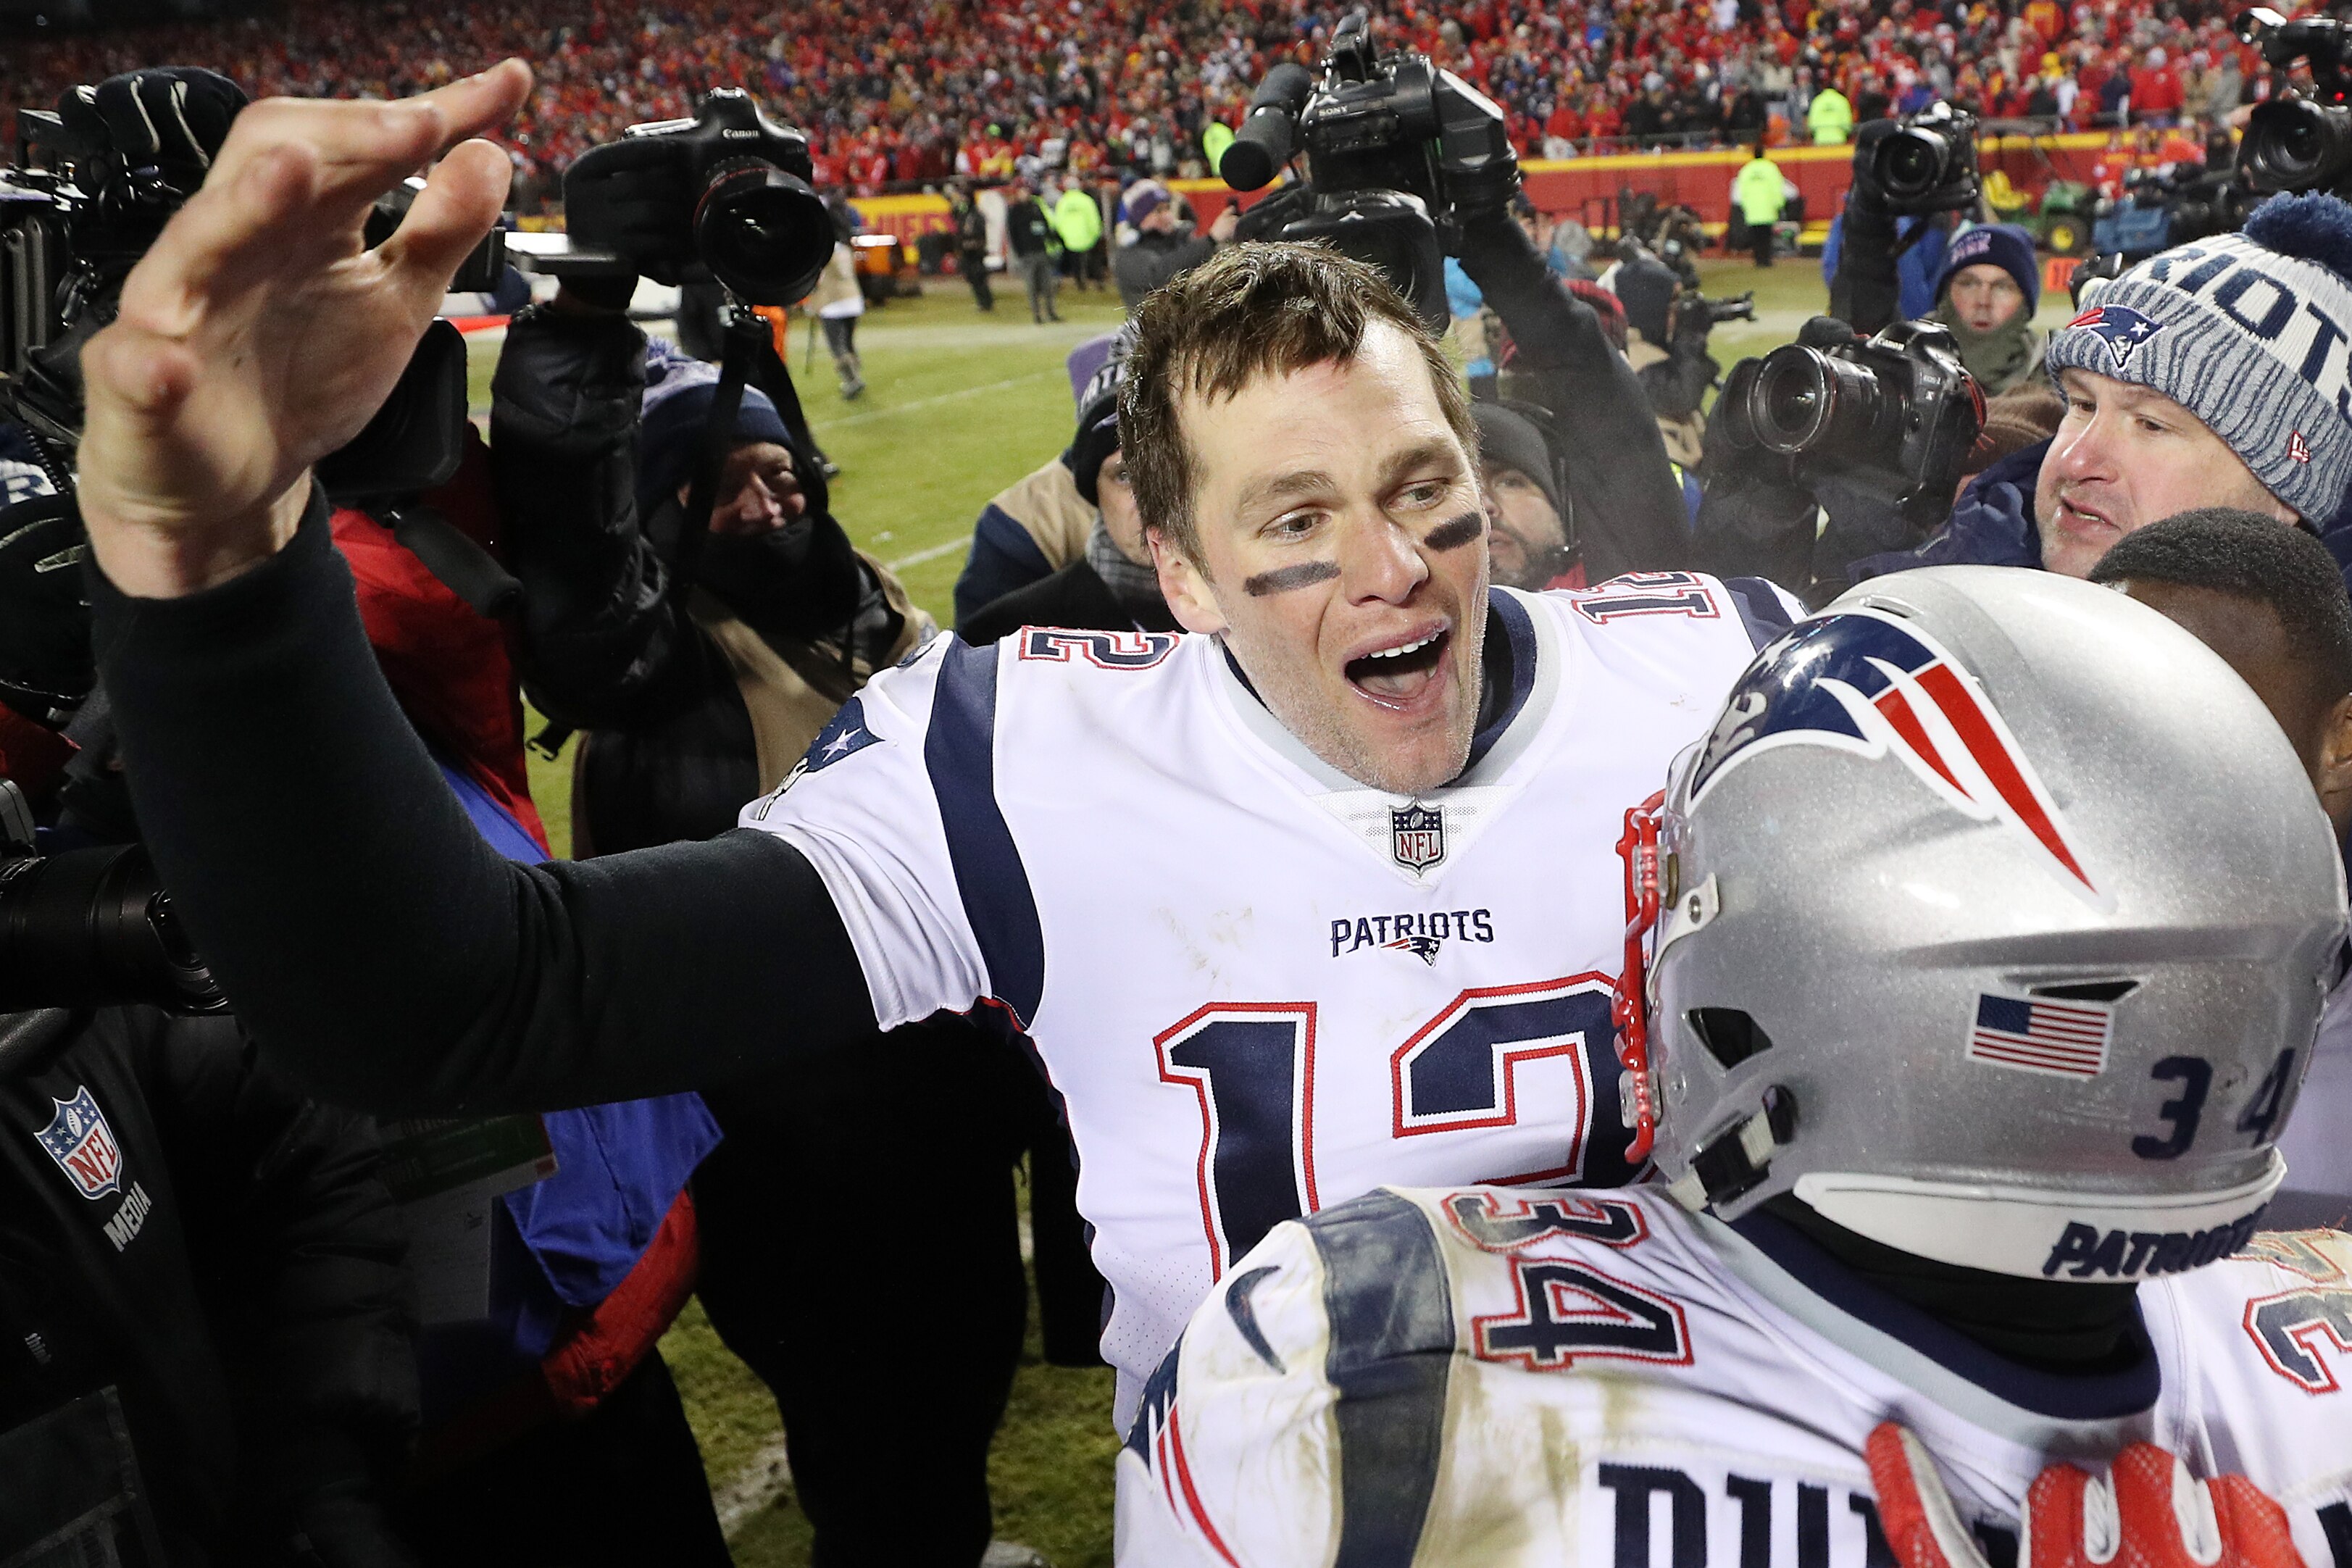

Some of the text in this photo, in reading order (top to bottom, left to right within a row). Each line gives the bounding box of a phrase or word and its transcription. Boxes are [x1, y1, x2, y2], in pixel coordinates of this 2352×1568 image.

[722, 128, 759, 139] Canon
[1319, 105, 1348, 116] SONY
[1877, 337, 1906, 352] Canon
[1398, 831, 1440, 862] NFL
[1330, 909, 1495, 958] PATRIOTS
[2132, 1048, 2296, 1161] 34
[67, 1128, 117, 1190] NFL
[103, 1180, 153, 1253] MEDIA
[1440, 1191, 1696, 1372] 34
